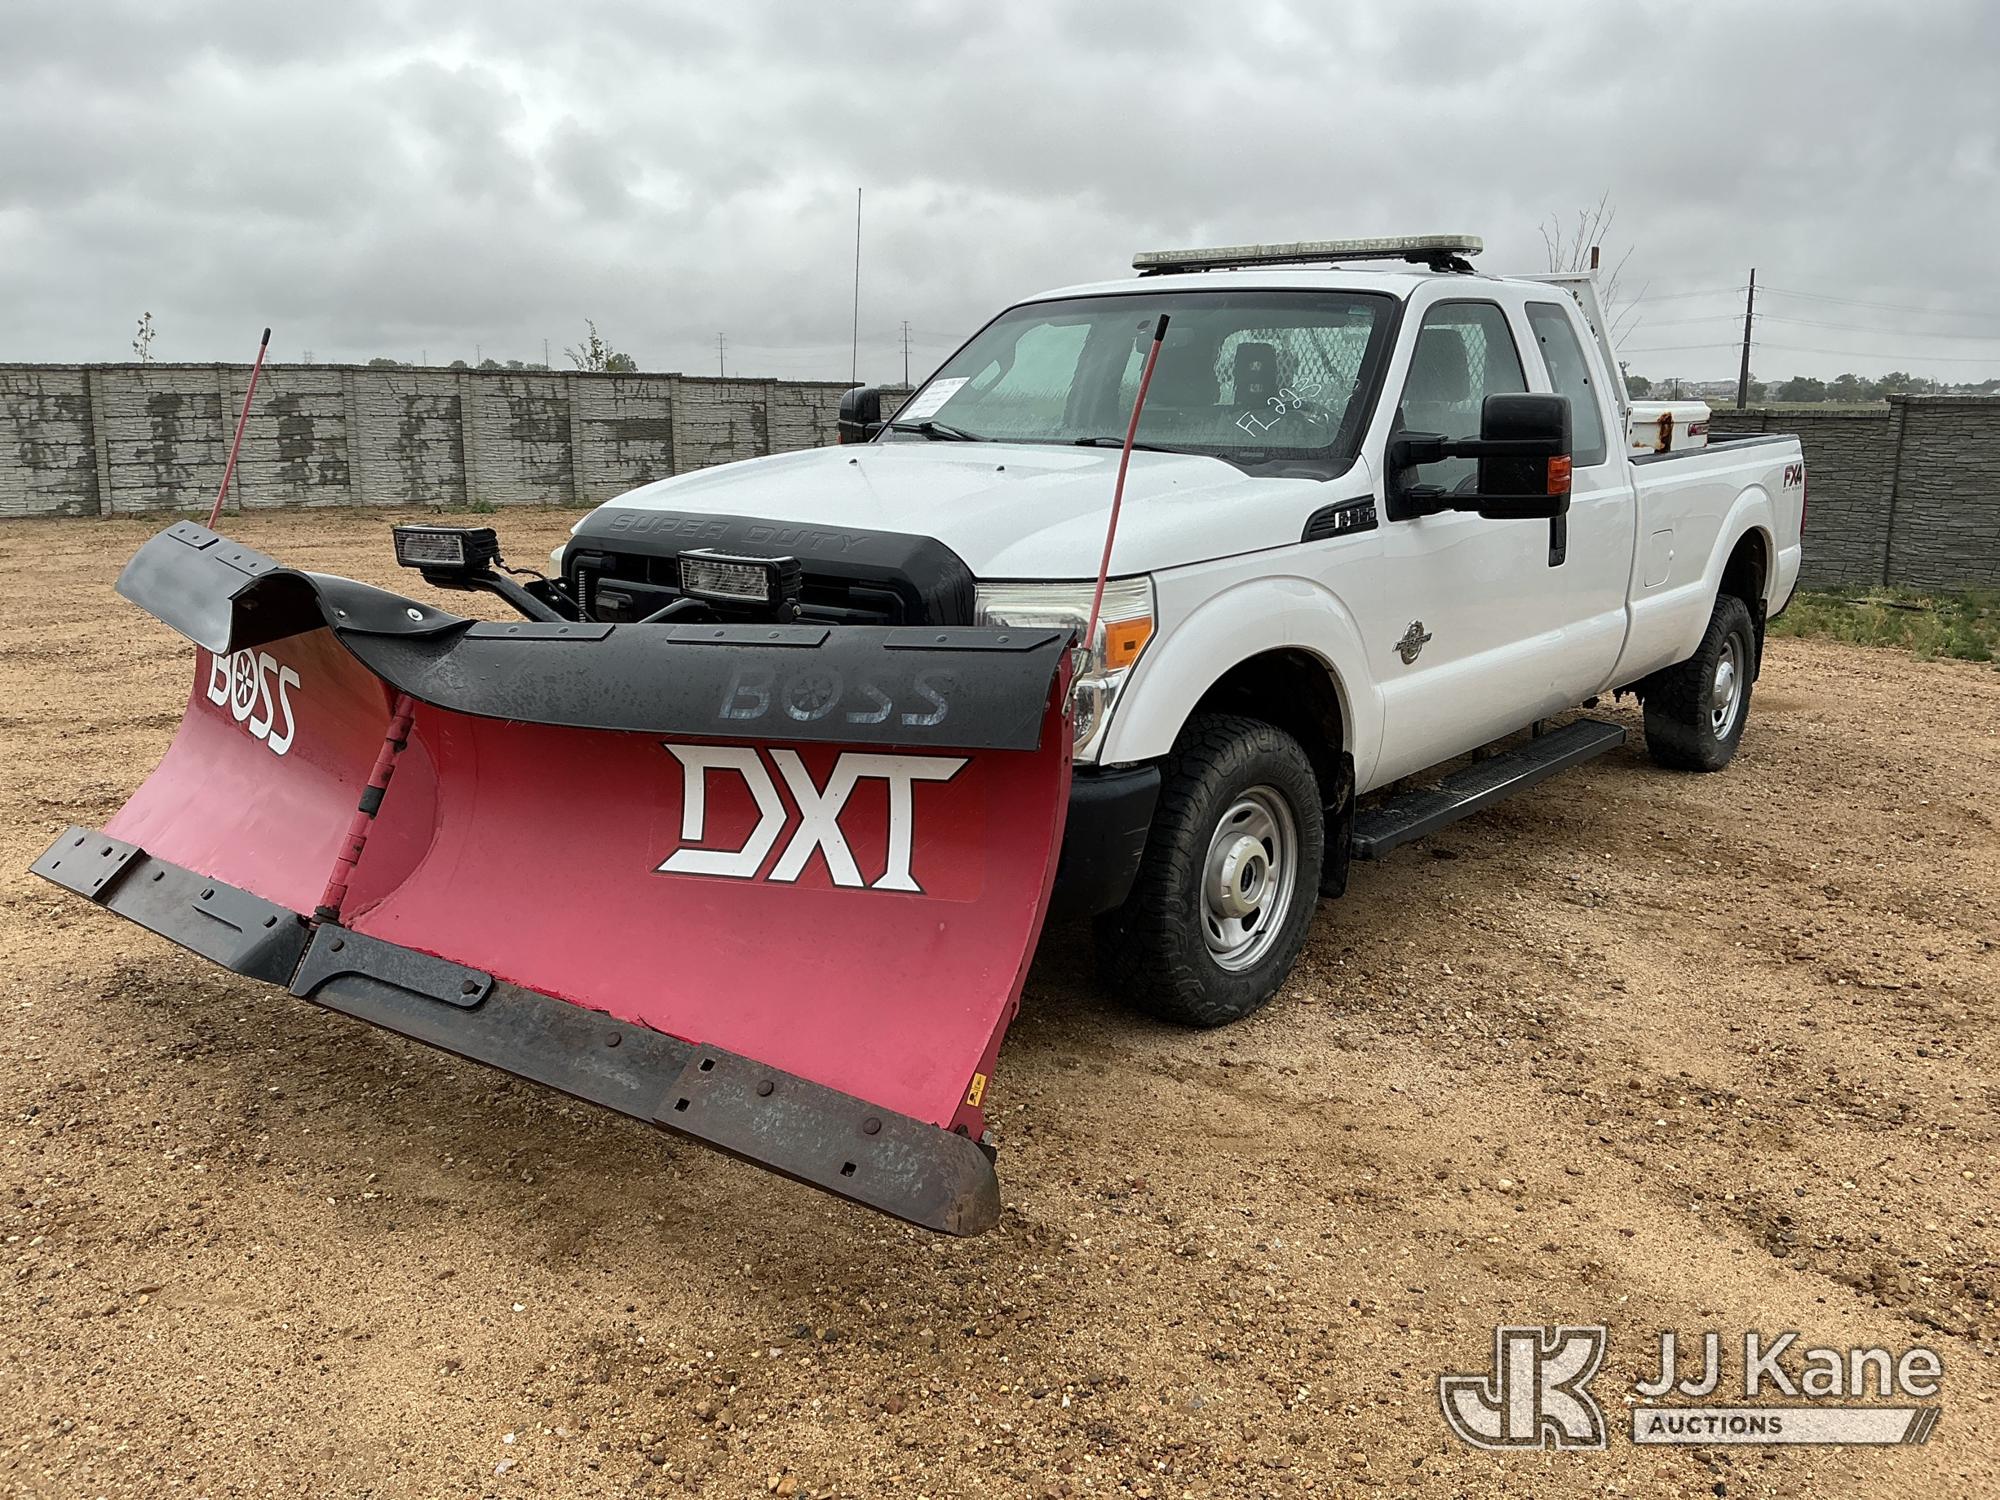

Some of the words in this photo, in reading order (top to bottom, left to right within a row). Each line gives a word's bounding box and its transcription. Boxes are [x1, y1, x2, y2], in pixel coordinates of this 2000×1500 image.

[1783, 463, 1802, 487] FX4
[609, 513, 731, 541] SUPER
[741, 525, 871, 552] DUTY
[206, 647, 301, 756] BOSS
[718, 662, 958, 727] BOSS
[652, 742, 972, 893] DXT
